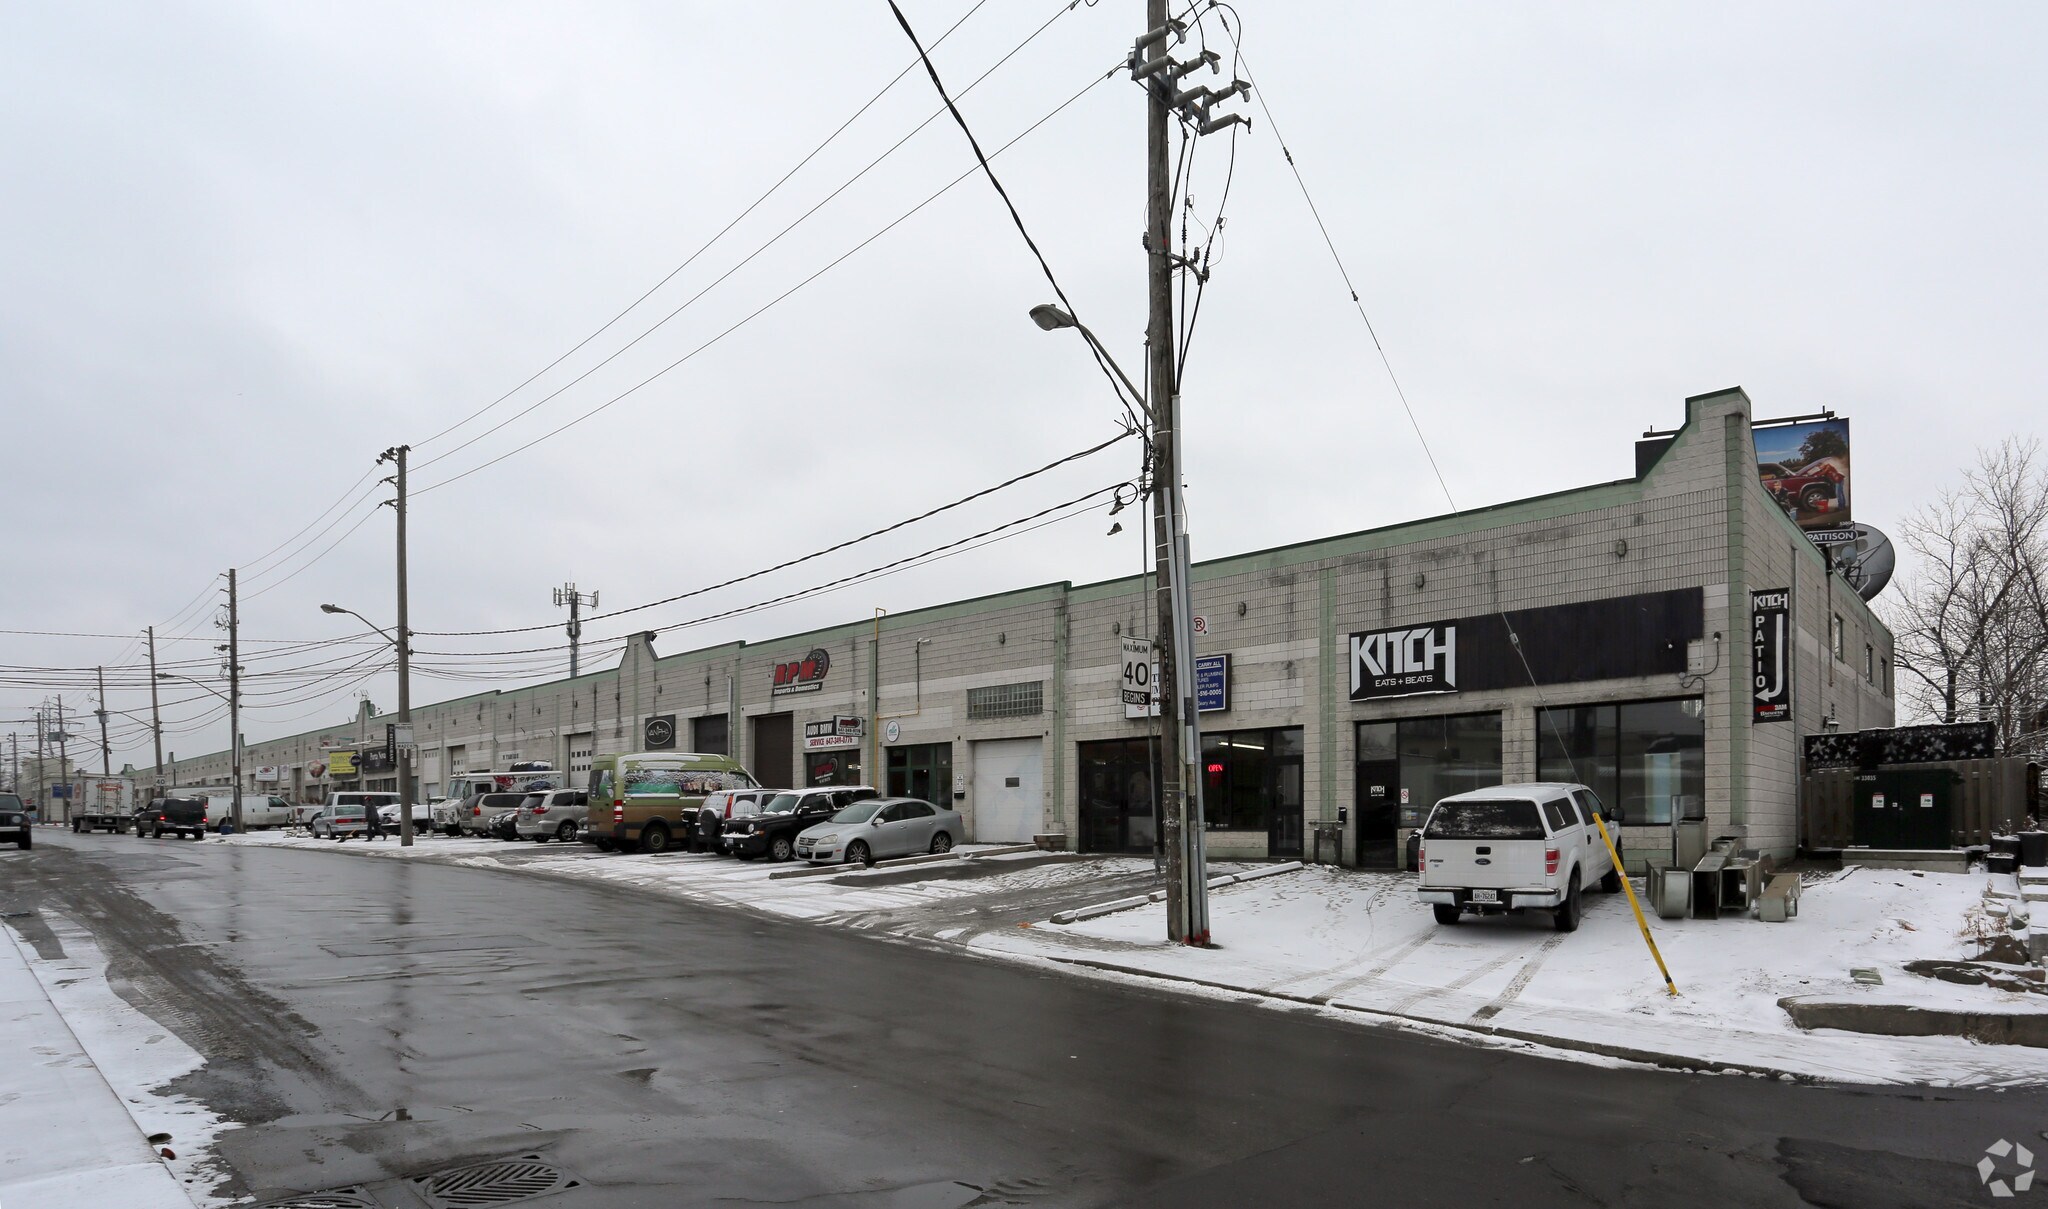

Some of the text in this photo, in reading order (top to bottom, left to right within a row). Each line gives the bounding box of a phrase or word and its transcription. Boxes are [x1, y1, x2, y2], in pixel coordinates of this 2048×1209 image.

[1807, 531, 1854, 541] PATTISON
[1753, 593, 1788, 612] KITCH
[1123, 644, 1148, 654] MAXIMUM
[1755, 615, 1766, 688] PATIO
[1350, 626, 1456, 695] KITCH
[774, 661, 816, 685] RPM
[1123, 661, 1149, 687] 40
[1375, 678, 1397, 687] EATS
[1405, 675, 1433, 685] BEATS
[1123, 691, 1146, 704] BEGINS
[806, 722, 833, 736] AUDI BMW
[809, 738, 824, 747] SERVICE
[1208, 764, 1223, 773] OPEN
